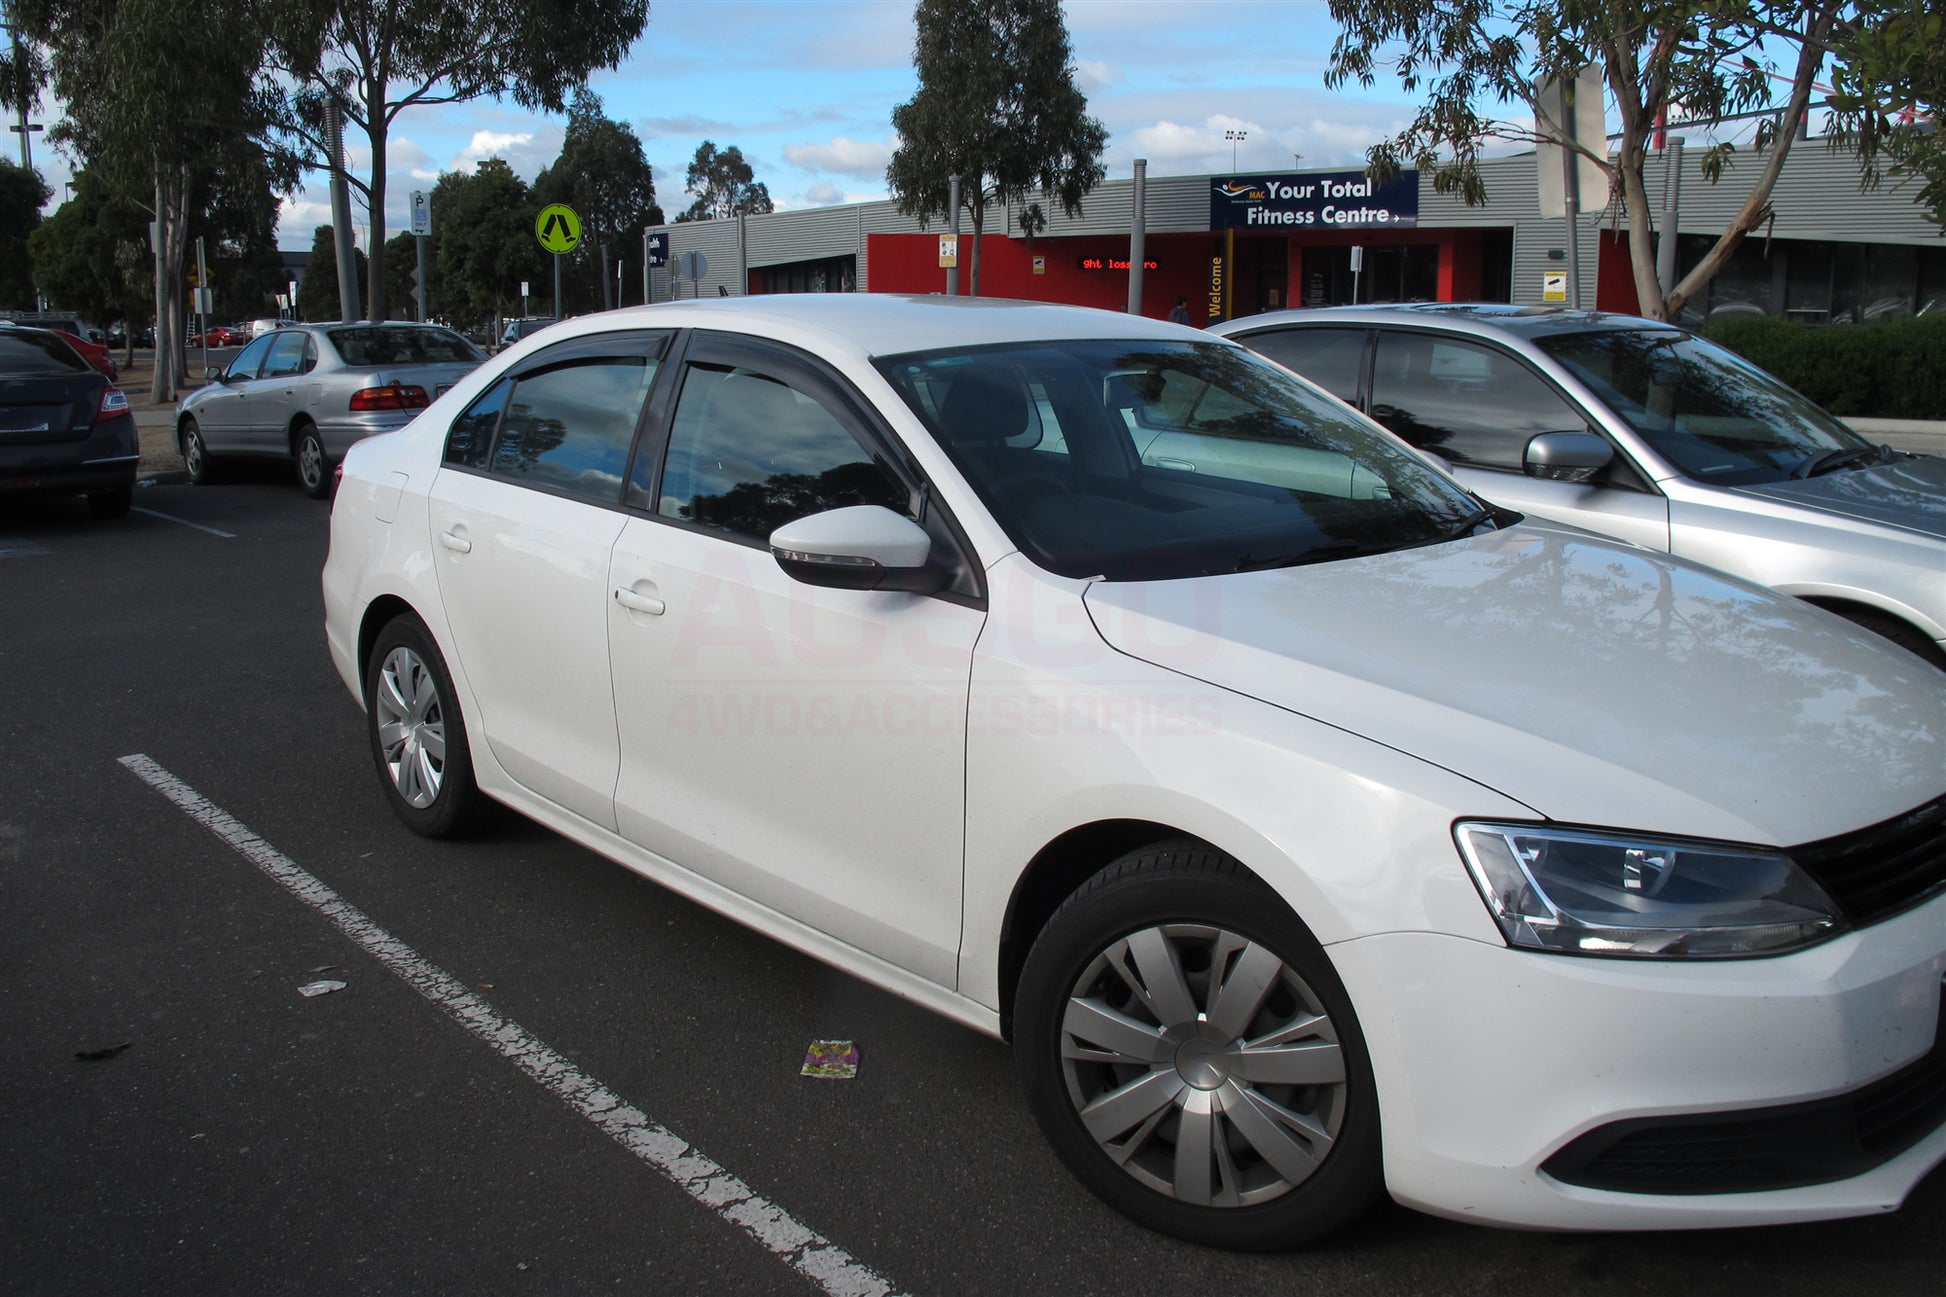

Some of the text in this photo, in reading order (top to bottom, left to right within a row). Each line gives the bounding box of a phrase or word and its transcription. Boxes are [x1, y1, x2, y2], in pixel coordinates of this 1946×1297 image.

[1249, 191, 1265, 199] MAC
[1266, 177, 1372, 199] Your Total
[416, 197, 424, 207] P
[1247, 205, 1389, 225] Fitness Centre
[1083, 259, 1102, 269] ght
[1143, 261, 1157, 269] ro
[1209, 256, 1222, 317] Welcome
